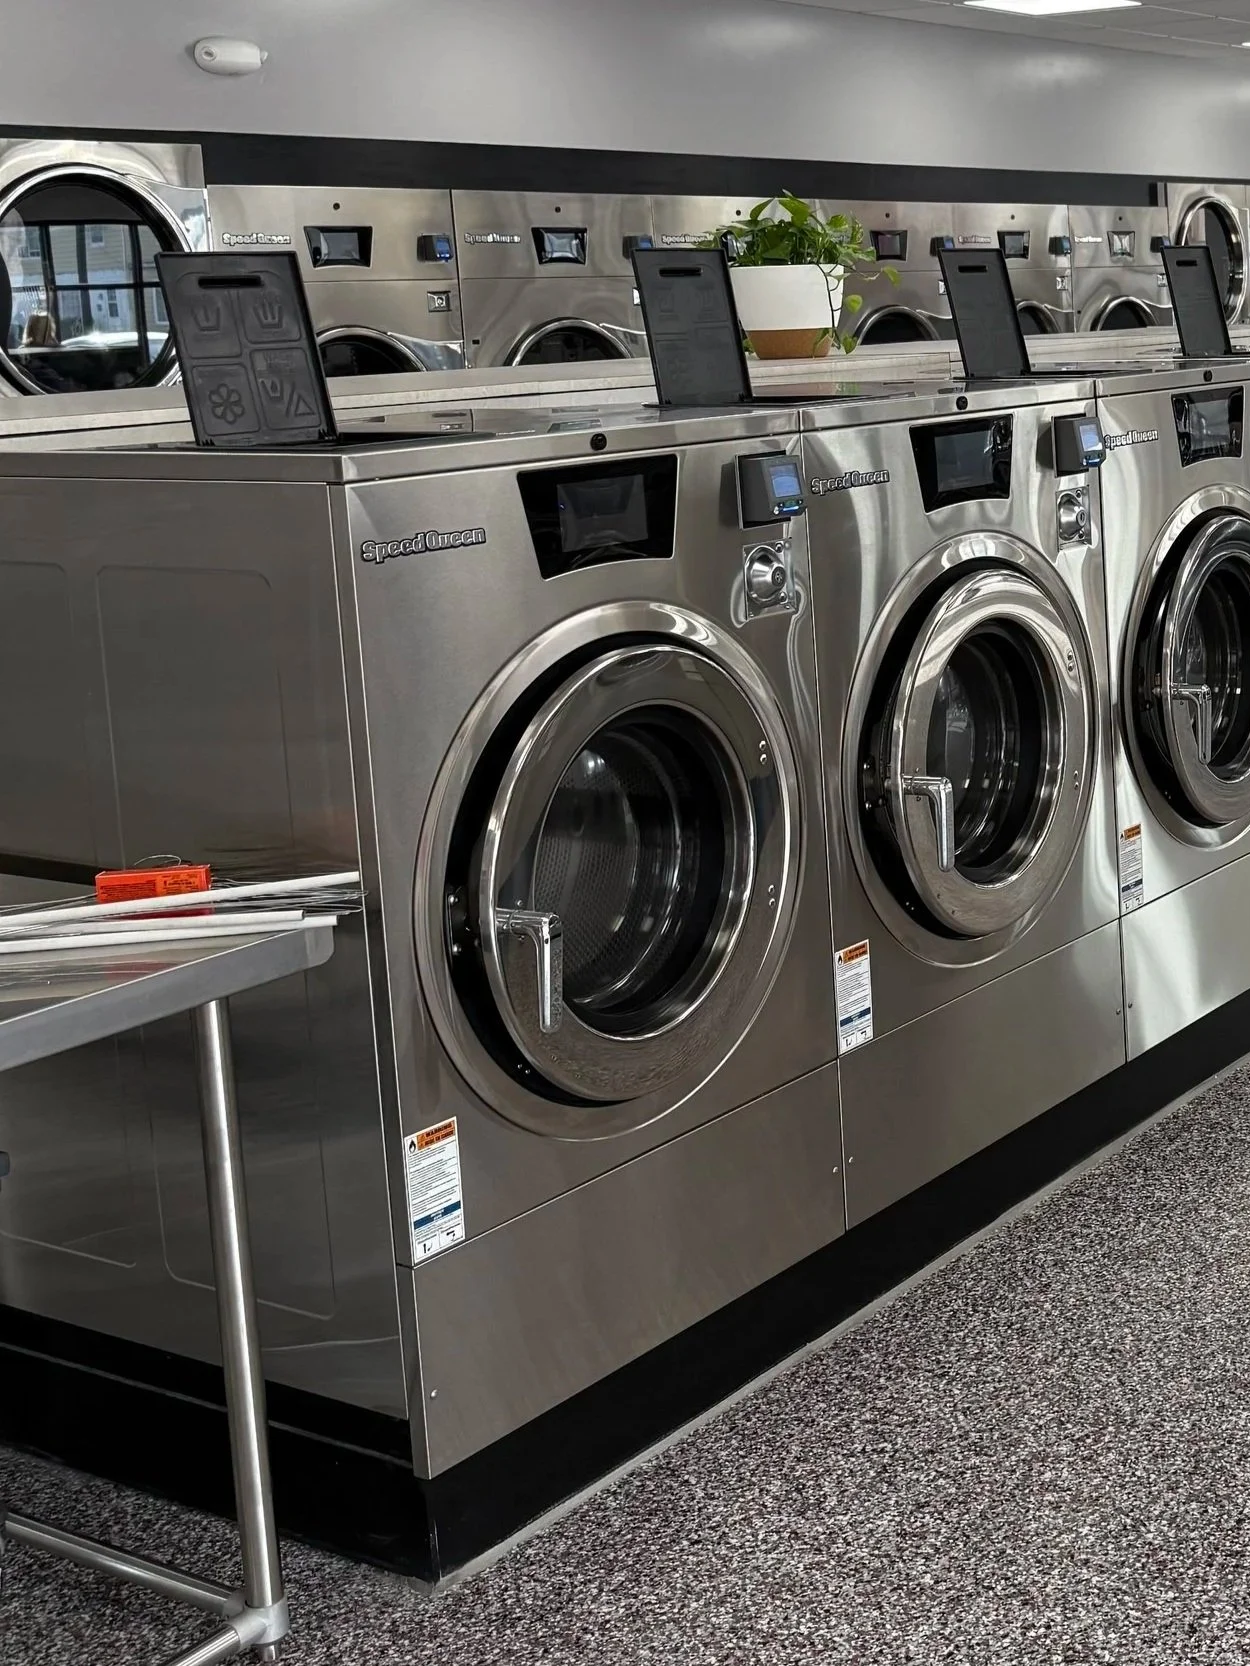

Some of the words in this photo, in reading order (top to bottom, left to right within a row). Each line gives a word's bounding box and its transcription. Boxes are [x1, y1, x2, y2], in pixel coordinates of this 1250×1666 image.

[222, 233, 257, 246] Speed
[1104, 430, 1133, 451] Speed
[1132, 430, 1159, 444] Queen
[811, 471, 852, 496] Speed
[851, 469, 890, 487] Queen
[361, 532, 426, 565] Speed
[425, 527, 487, 552] Queen
